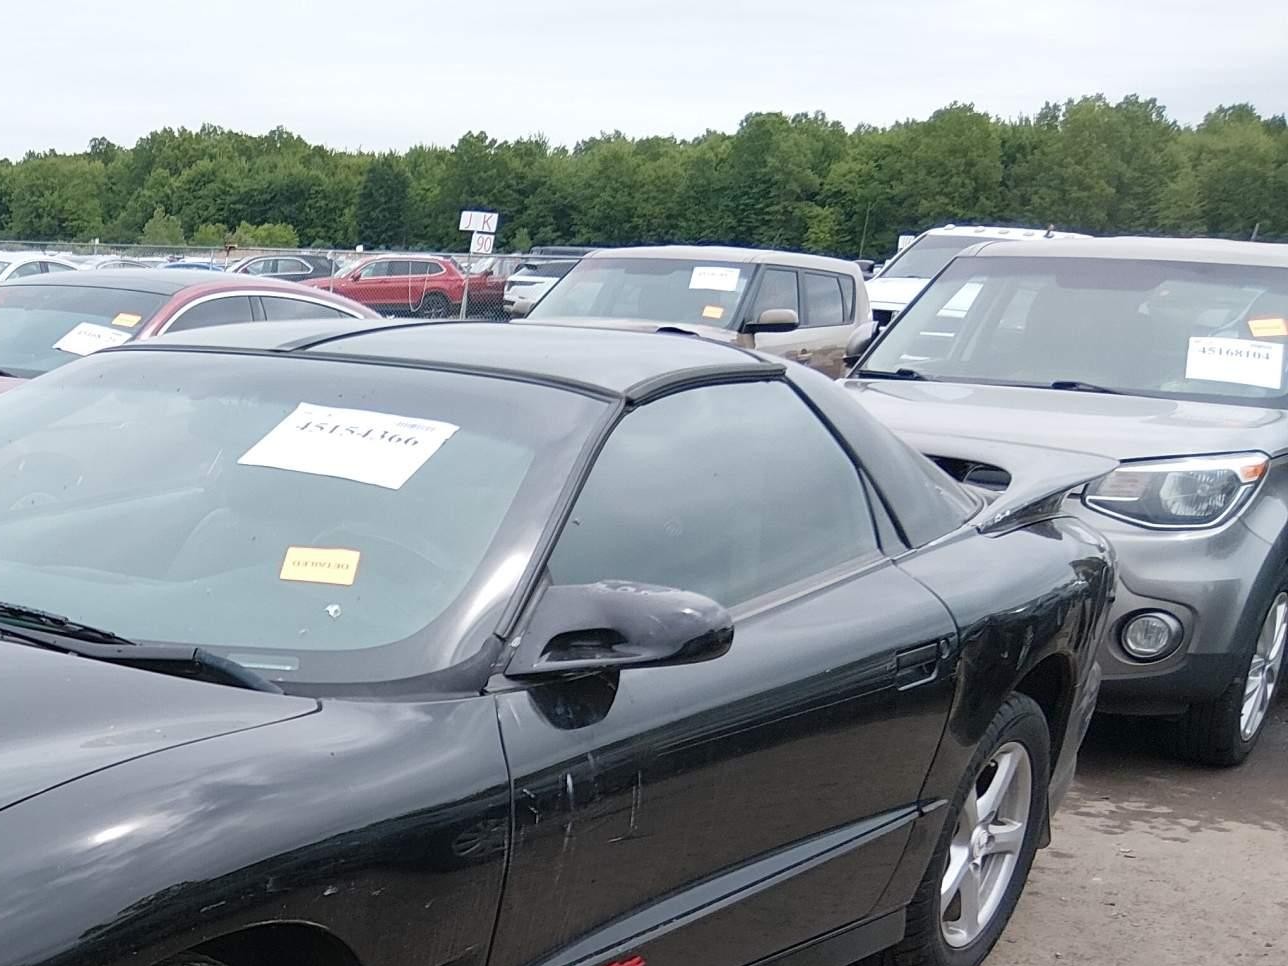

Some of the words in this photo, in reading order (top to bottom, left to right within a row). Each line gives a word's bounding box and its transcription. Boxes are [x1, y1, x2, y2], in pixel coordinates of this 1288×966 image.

[464, 212, 473, 229] J
[481, 214, 494, 231] K
[475, 235, 492, 253] 90
[295, 420, 420, 448] 45154366
